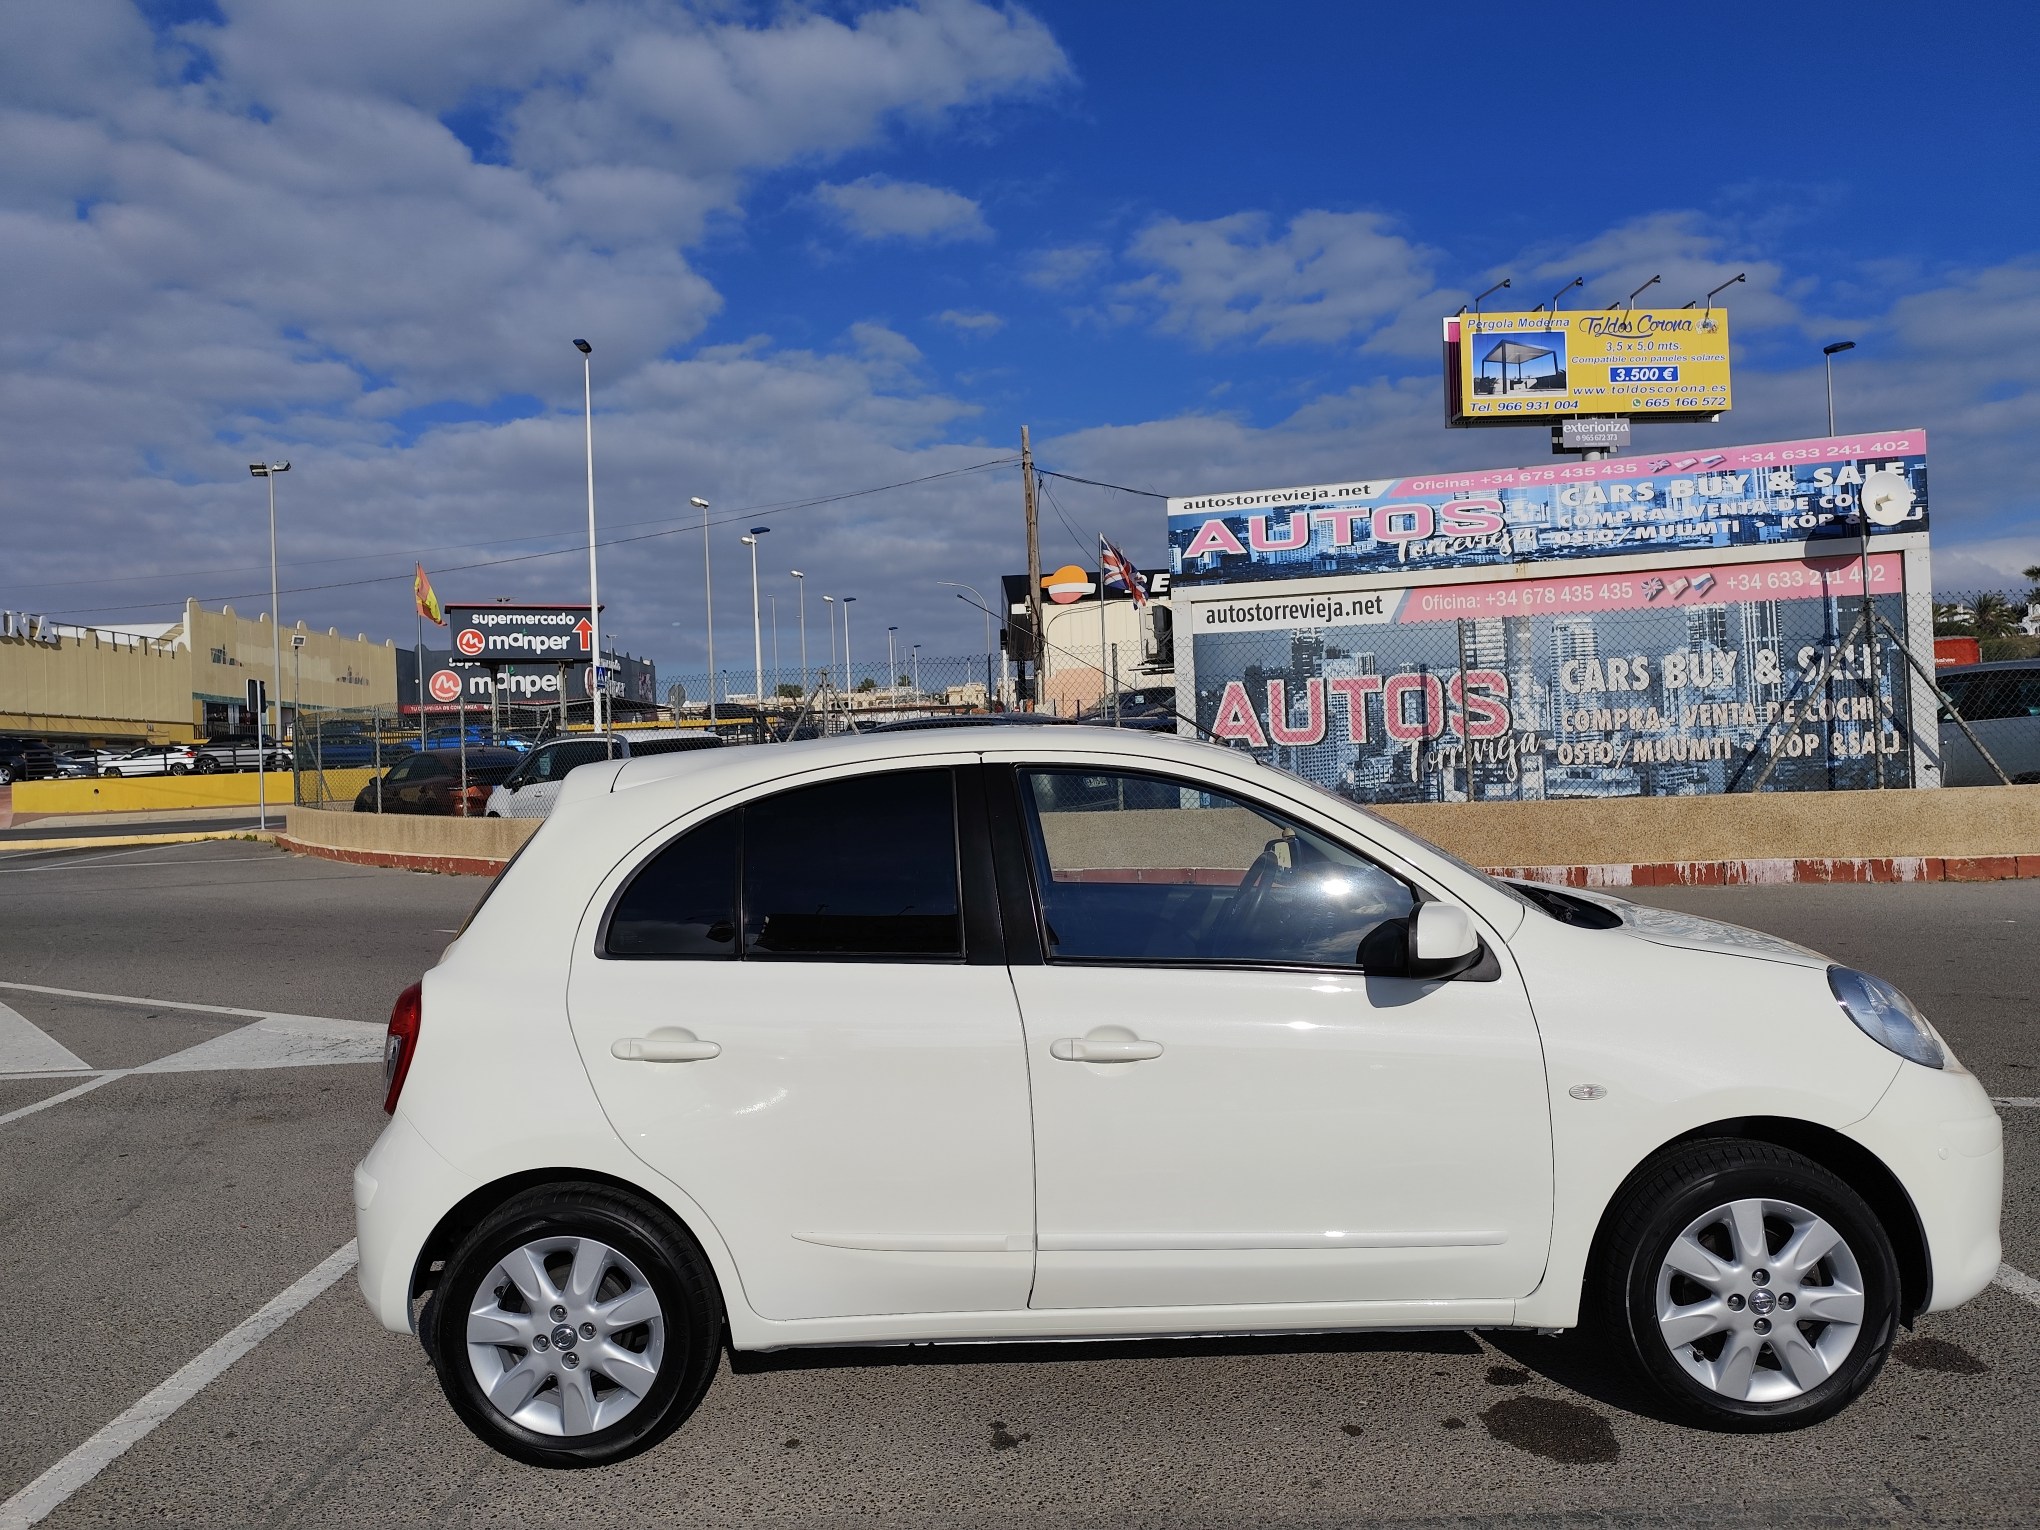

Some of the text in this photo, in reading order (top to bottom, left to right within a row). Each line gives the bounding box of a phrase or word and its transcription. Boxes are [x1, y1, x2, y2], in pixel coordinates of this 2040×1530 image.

[1468, 317, 1570, 331] Pergola Moderna
[1637, 314, 1694, 334] Corona
[1605, 341, 1682, 352] 3,5 x 5,0 mts.
[1571, 355, 1627, 365] Compatible
[1650, 354, 1688, 364] paneles
[1690, 353, 1726, 362] solares
[1615, 367, 1674, 381] 3.500 €
[1573, 384, 1727, 395] www.toldoscorona.es
[1470, 400, 1578, 412] Tel. 966 931 004
[1645, 396, 1726, 408] 665 166 572
[1563, 421, 1629, 433] exterioriza
[1738, 440, 1910, 463] +34 633 241 402
[1412, 463, 1637, 491] Oficina: +34 678 435 435
[1560, 481, 1654, 506] CARS
[1670, 474, 1750, 498] BUY
[1768, 471, 1798, 491] &
[1183, 483, 1371, 511] autostorrevieja.net
[1559, 507, 1665, 528] COMPRA
[1690, 500, 1770, 518] VENTA
[1778, 496, 1809, 511] DE
[1781, 512, 1835, 529] KÖP
[1182, 499, 1506, 559] AUTOS
[1395, 528, 1538, 563] Torrevieja
[1727, 573, 1762, 591] +34
[1767, 571, 1804, 589] 633
[1809, 567, 1844, 586] 241
[1421, 582, 1633, 611] Oficina: +34 678 435 435
[471, 612, 575, 627] supermercado
[1206, 595, 1383, 624] autostorrevieja.net
[488, 633, 570, 654] manper
[1561, 643, 1882, 694] CARS BUY & SALE
[1209, 668, 1512, 748] AUTOS
[1562, 706, 1660, 732] COMPRA
[1682, 703, 1758, 728] VENTA
[1766, 700, 1797, 724] DE
